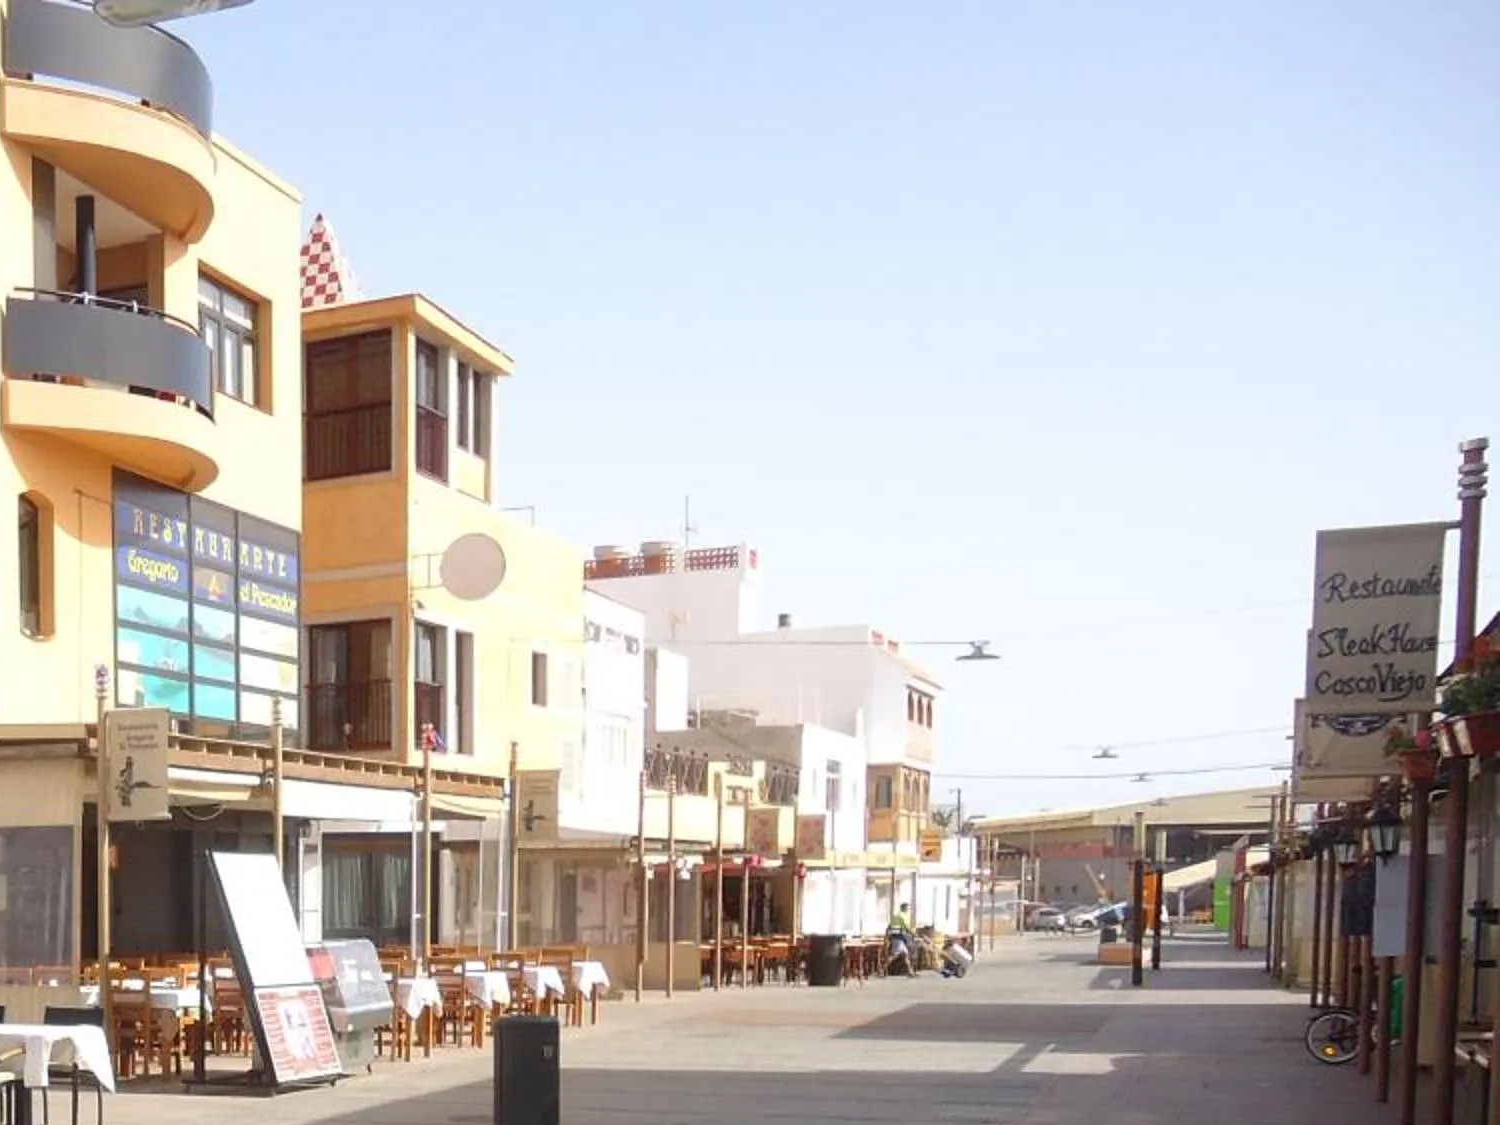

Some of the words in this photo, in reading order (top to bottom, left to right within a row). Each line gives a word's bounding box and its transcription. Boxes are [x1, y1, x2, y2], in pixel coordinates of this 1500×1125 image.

[1316, 623, 1389, 659] Steak
[1314, 669, 1377, 696] Casco
[1371, 662, 1426, 703] Viejo
